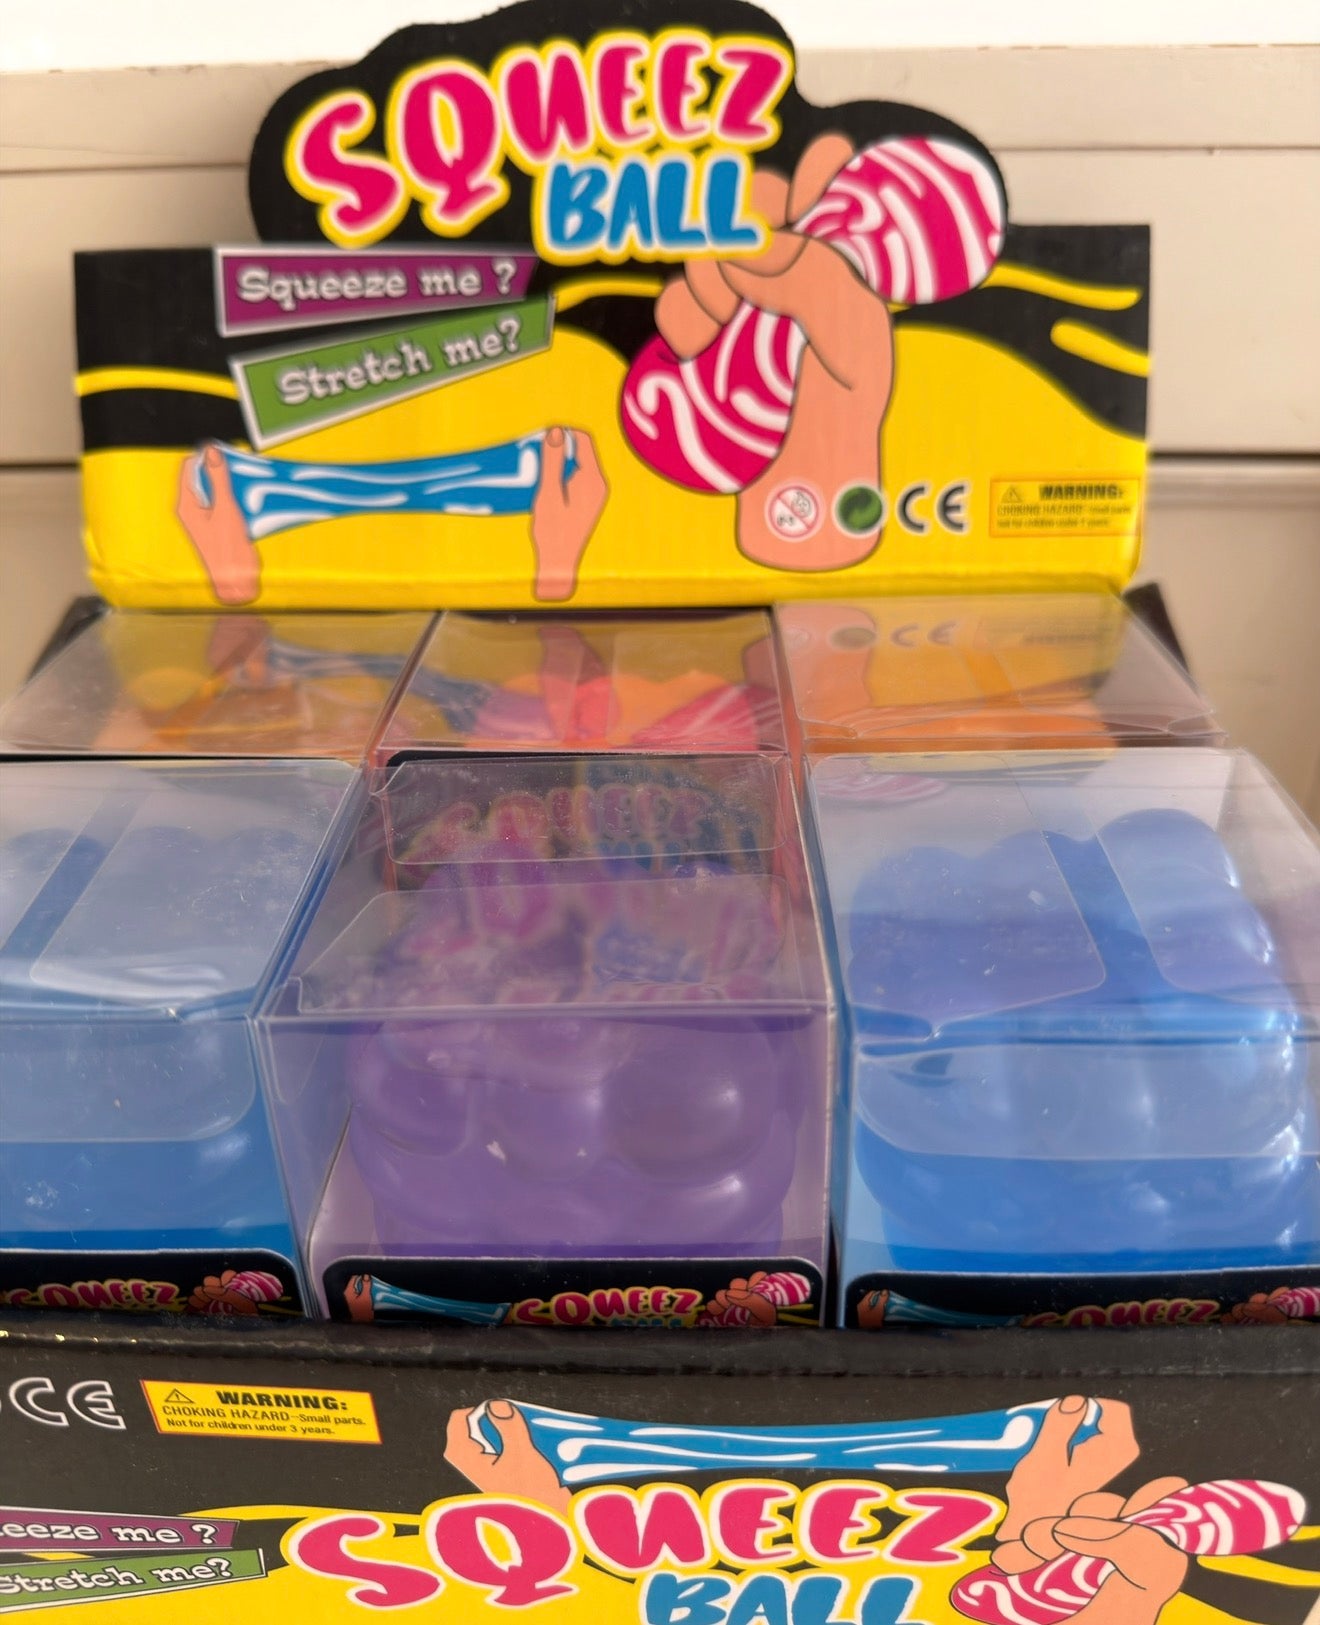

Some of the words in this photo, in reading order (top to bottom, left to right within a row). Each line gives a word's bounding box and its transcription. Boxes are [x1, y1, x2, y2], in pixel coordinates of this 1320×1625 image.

[298, 42, 787, 235] SQUEEZ
[548, 160, 761, 250] BALL
[238, 267, 407, 311] Squeeze
[419, 267, 481, 296] me
[494, 257, 517, 295] ?
[279, 340, 432, 404] Stretch
[443, 318, 521, 386] me?
[897, 485, 966, 533] CE
[8, 1376, 127, 1430] CE
[163, 1405, 226, 1418] CHOKING
[335, 1416, 367, 1427] parts.
[216, 1390, 348, 1411] WARNING:
[167, 1418, 187, 1428] Not
[189, 1419, 205, 1429] for
[208, 1420, 252, 1431] children
[255, 1422, 287, 1433] under
[290, 1424, 298, 1433] 3
[300, 1426, 336, 1436] years.
[0, 1521, 100, 1541] eeze
[111, 1526, 183, 1544] me
[191, 1523, 219, 1545] ?
[296, 1482, 998, 1608] SQUEEZ
[0, 1566, 144, 1595] Stretch
[150, 1557, 233, 1583] me?
[643, 1575, 930, 1625] BALL
